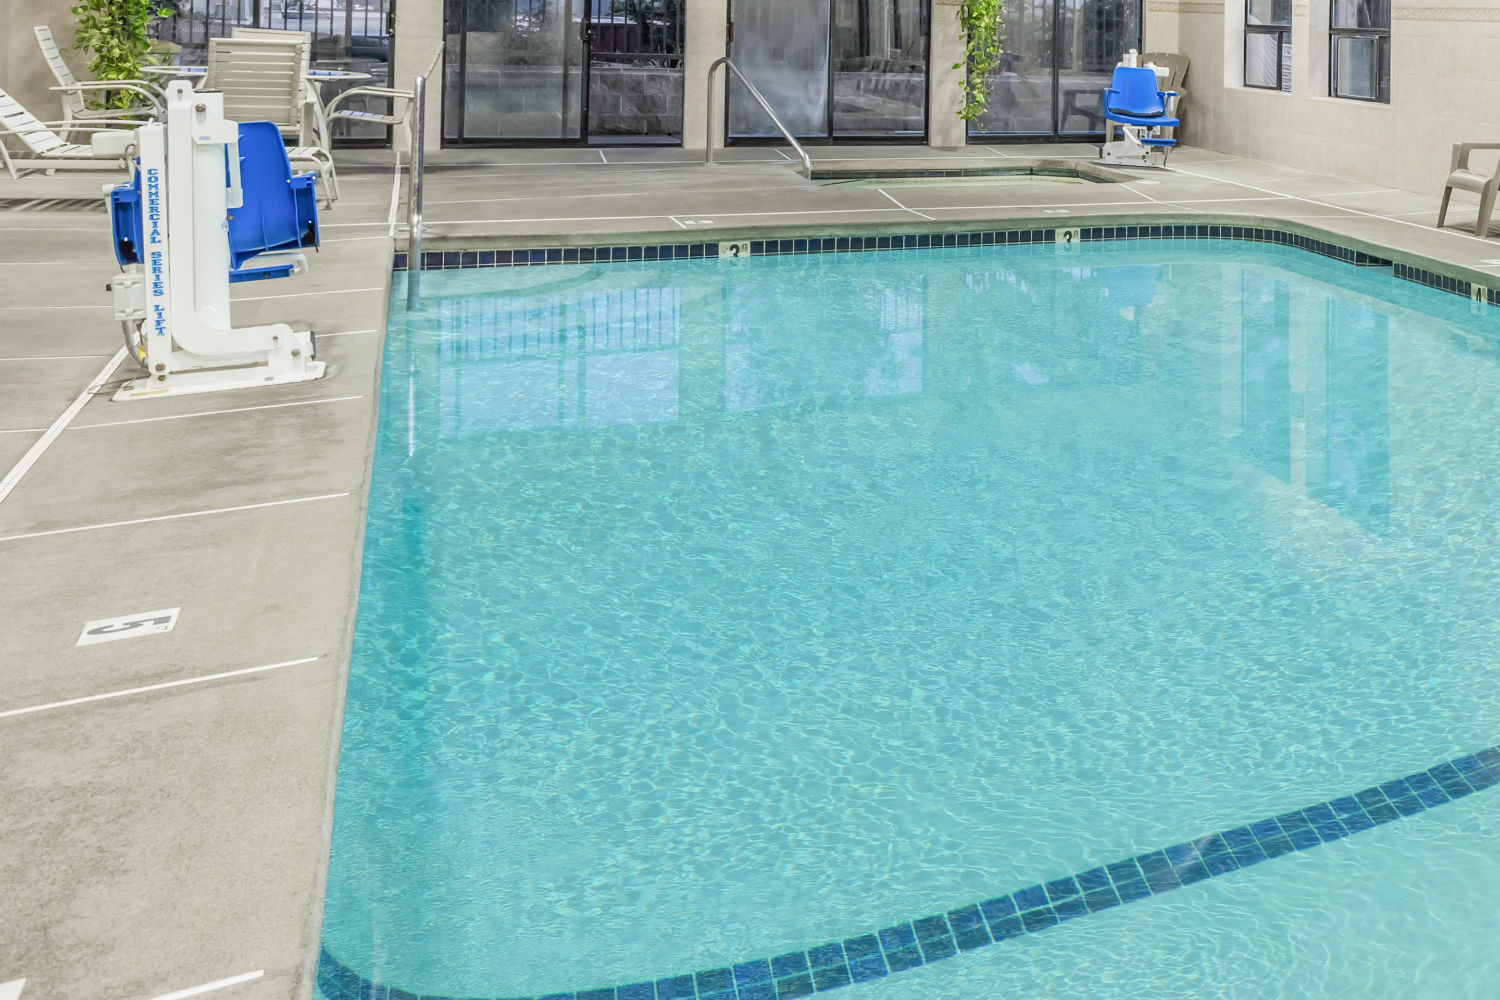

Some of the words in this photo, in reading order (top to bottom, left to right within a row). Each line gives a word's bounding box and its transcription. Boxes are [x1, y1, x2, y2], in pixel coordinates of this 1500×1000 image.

[147, 168, 161, 244] COMMERCIAL
[150, 251, 164, 297] SERIES
[153, 304, 167, 337] LIFT
